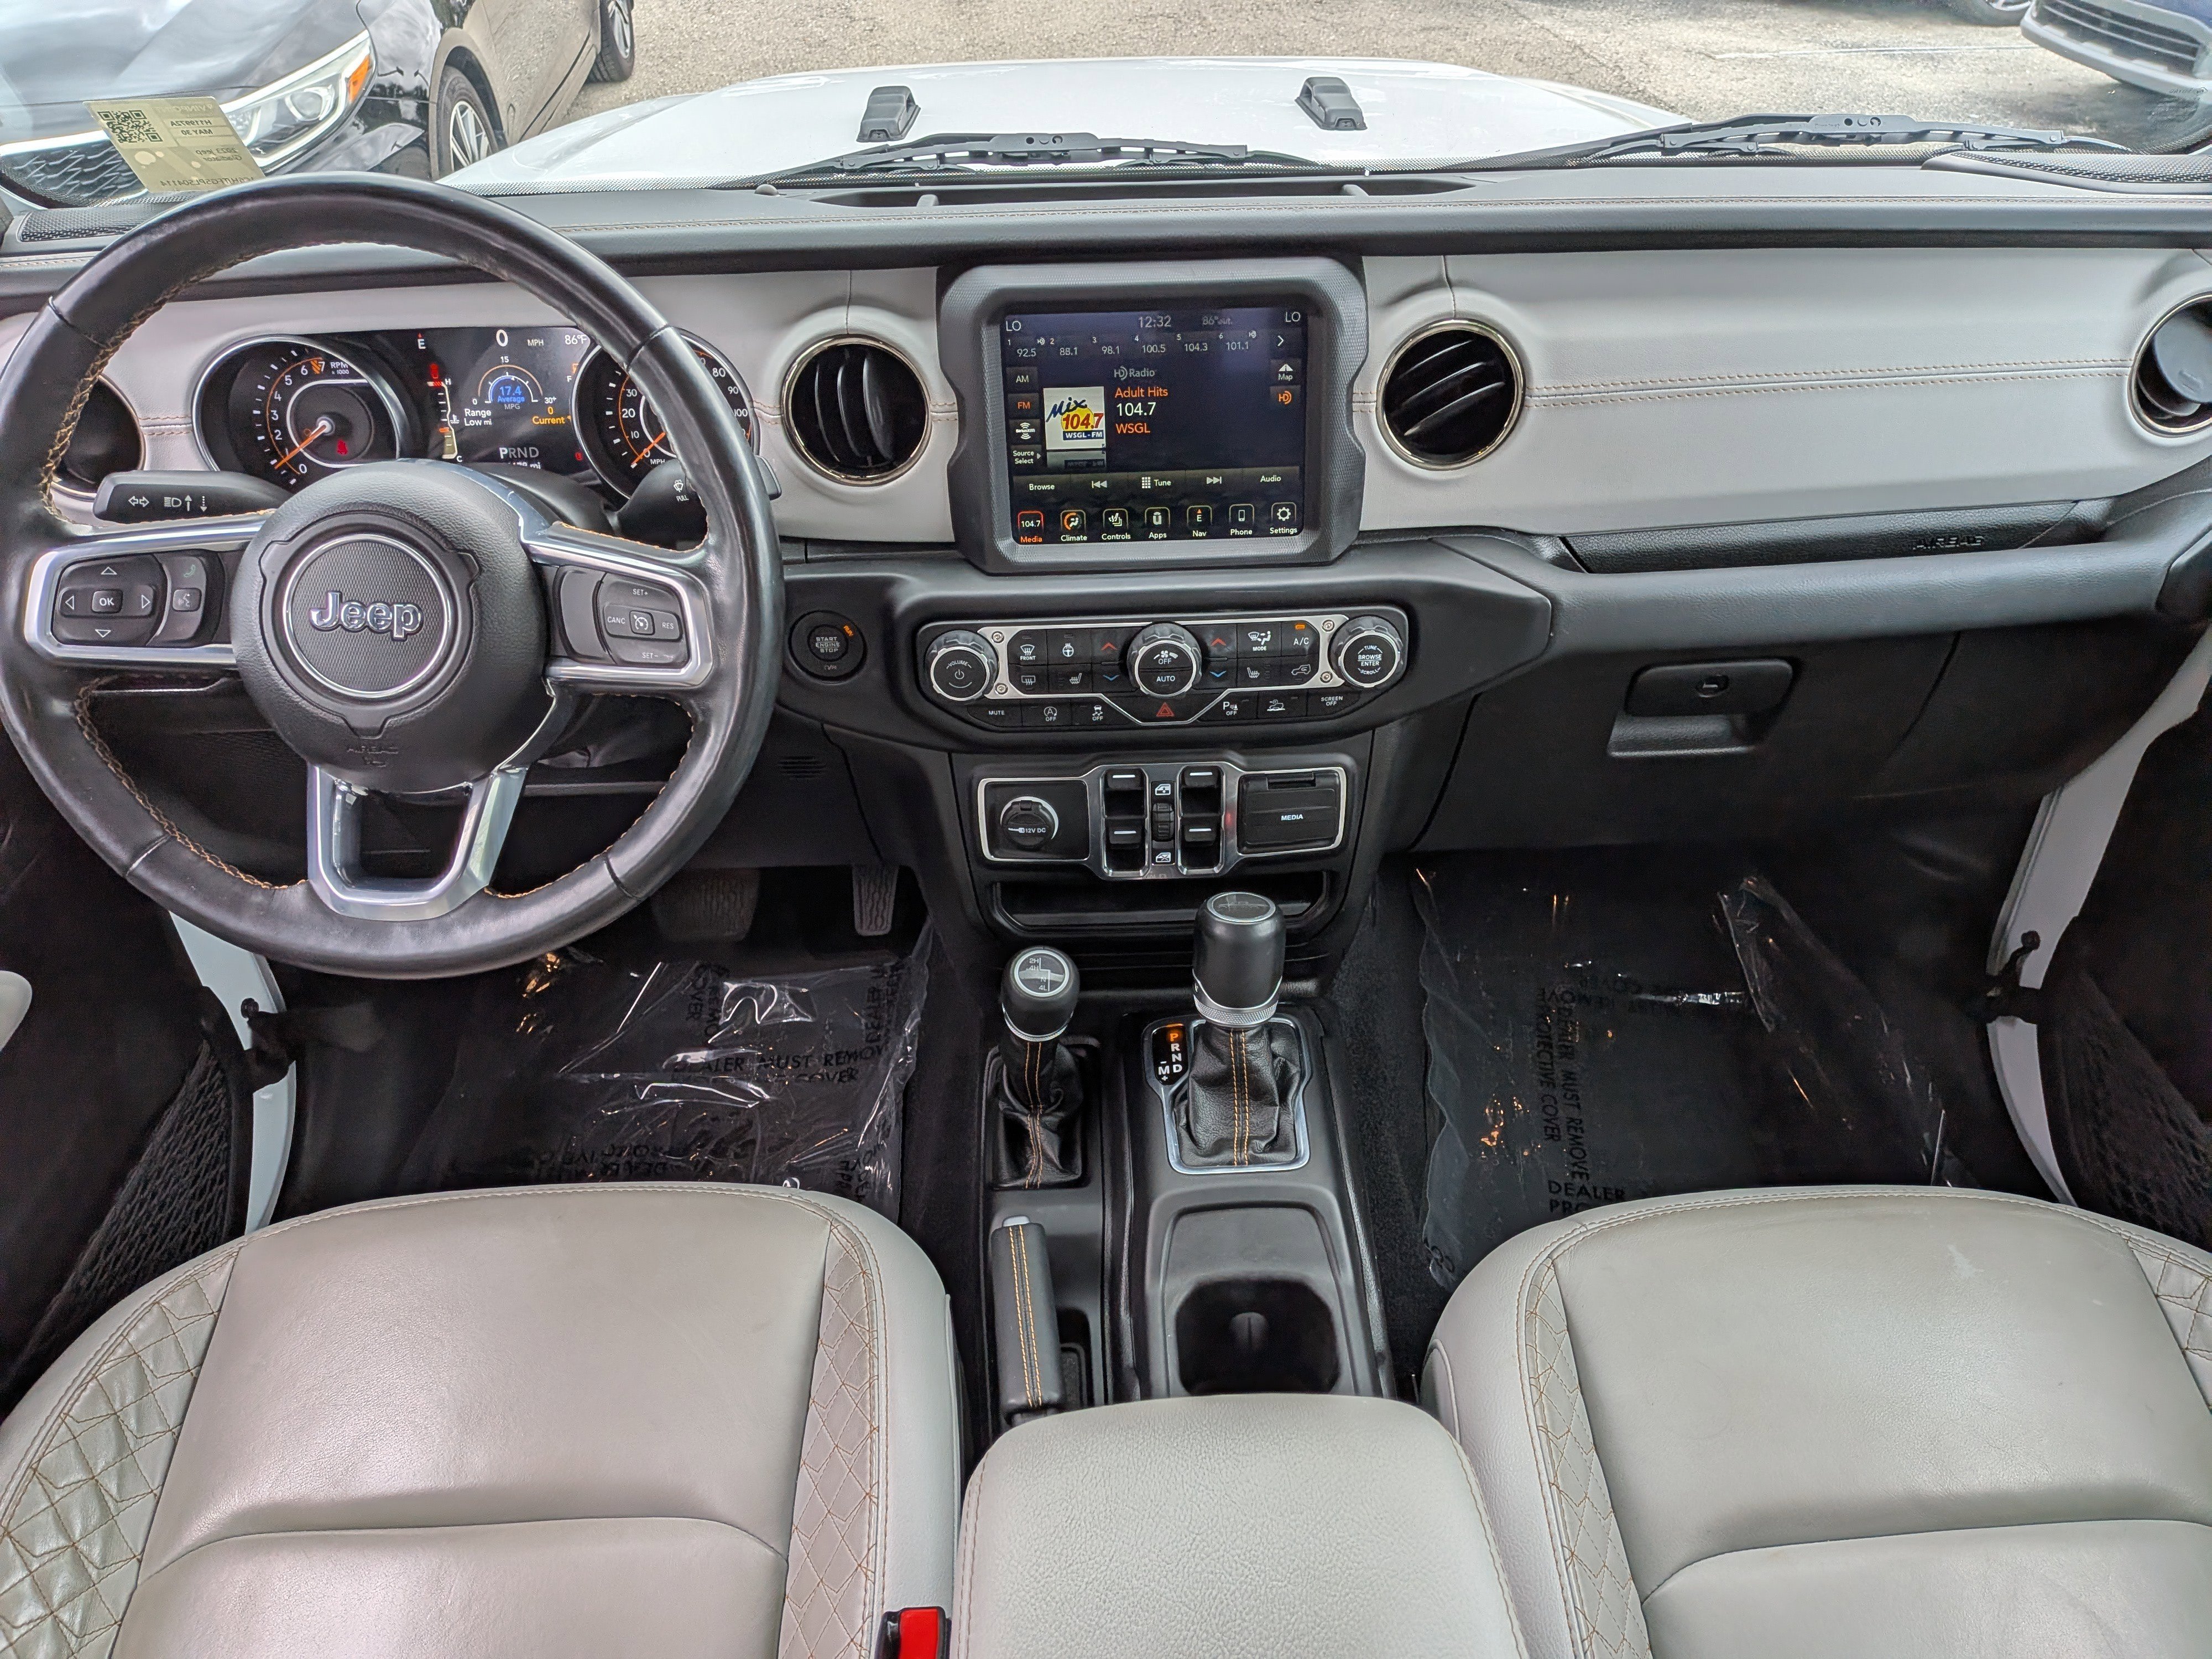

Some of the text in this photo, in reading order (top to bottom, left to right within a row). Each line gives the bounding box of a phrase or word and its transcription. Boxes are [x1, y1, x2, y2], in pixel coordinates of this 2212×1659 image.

[1138, 315, 1172, 328] 12:32
[1285, 311, 1301, 322] LO
[1005, 320, 1021, 332] LO
[495, 329, 508, 347] 0
[418, 338, 426, 349] E
[1142, 344, 1166, 353] 100.5
[1184, 343, 1208, 352] 104.3
[1226, 341, 1249, 351] 101.1
[1016, 348, 1036, 357] 92.5
[1059, 346, 1078, 356] 88.1
[1102, 345, 1120, 355] 98.1
[300, 365, 308, 375] 6
[712, 367, 726, 378] 80
[1129, 369, 1156, 378] Radio
[284, 374, 293, 386] 5
[1015, 375, 1030, 383] AM
[1278, 373, 1293, 382] Map
[499, 385, 523, 396] 17.4
[626, 388, 638, 397] 30
[727, 386, 739, 394] 90
[1115, 386, 1168, 398] Adult Hits
[274, 390, 282, 401] 4
[464, 408, 492, 418] Range
[622, 408, 636, 418] 20
[1046, 397, 1088, 422] Mix
[1115, 401, 1156, 416] 104.7
[270, 410, 279, 421] 3
[532, 415, 565, 425] Current
[463, 418, 482, 426] Low
[1062, 413, 1104, 430] 104.7
[1115, 422, 1151, 434] WSGL
[274, 429, 283, 440] 2
[631, 430, 640, 439] 10
[298, 463, 307, 474] 0
[1260, 474, 1281, 483] Audio
[1269, 527, 1298, 536] Settings
[99, 597, 115, 607] OK
[310, 591, 422, 639] Jeep
[607, 616, 626, 625] CANC
[1293, 637, 1310, 646] A/C
[1281, 813, 1304, 821] MEDIA
[1170, 1032, 1179, 1042] P
[1171, 1043, 1181, 1052] R
[1172, 1053, 1182, 1062] N
[1158, 1066, 1170, 1076] M
[1172, 1063, 1183, 1073] D
[1540, 1093, 1562, 1143] COVER
[1566, 1117, 1590, 1182] REMOVE
[1548, 1179, 1626, 1202] DEALER
